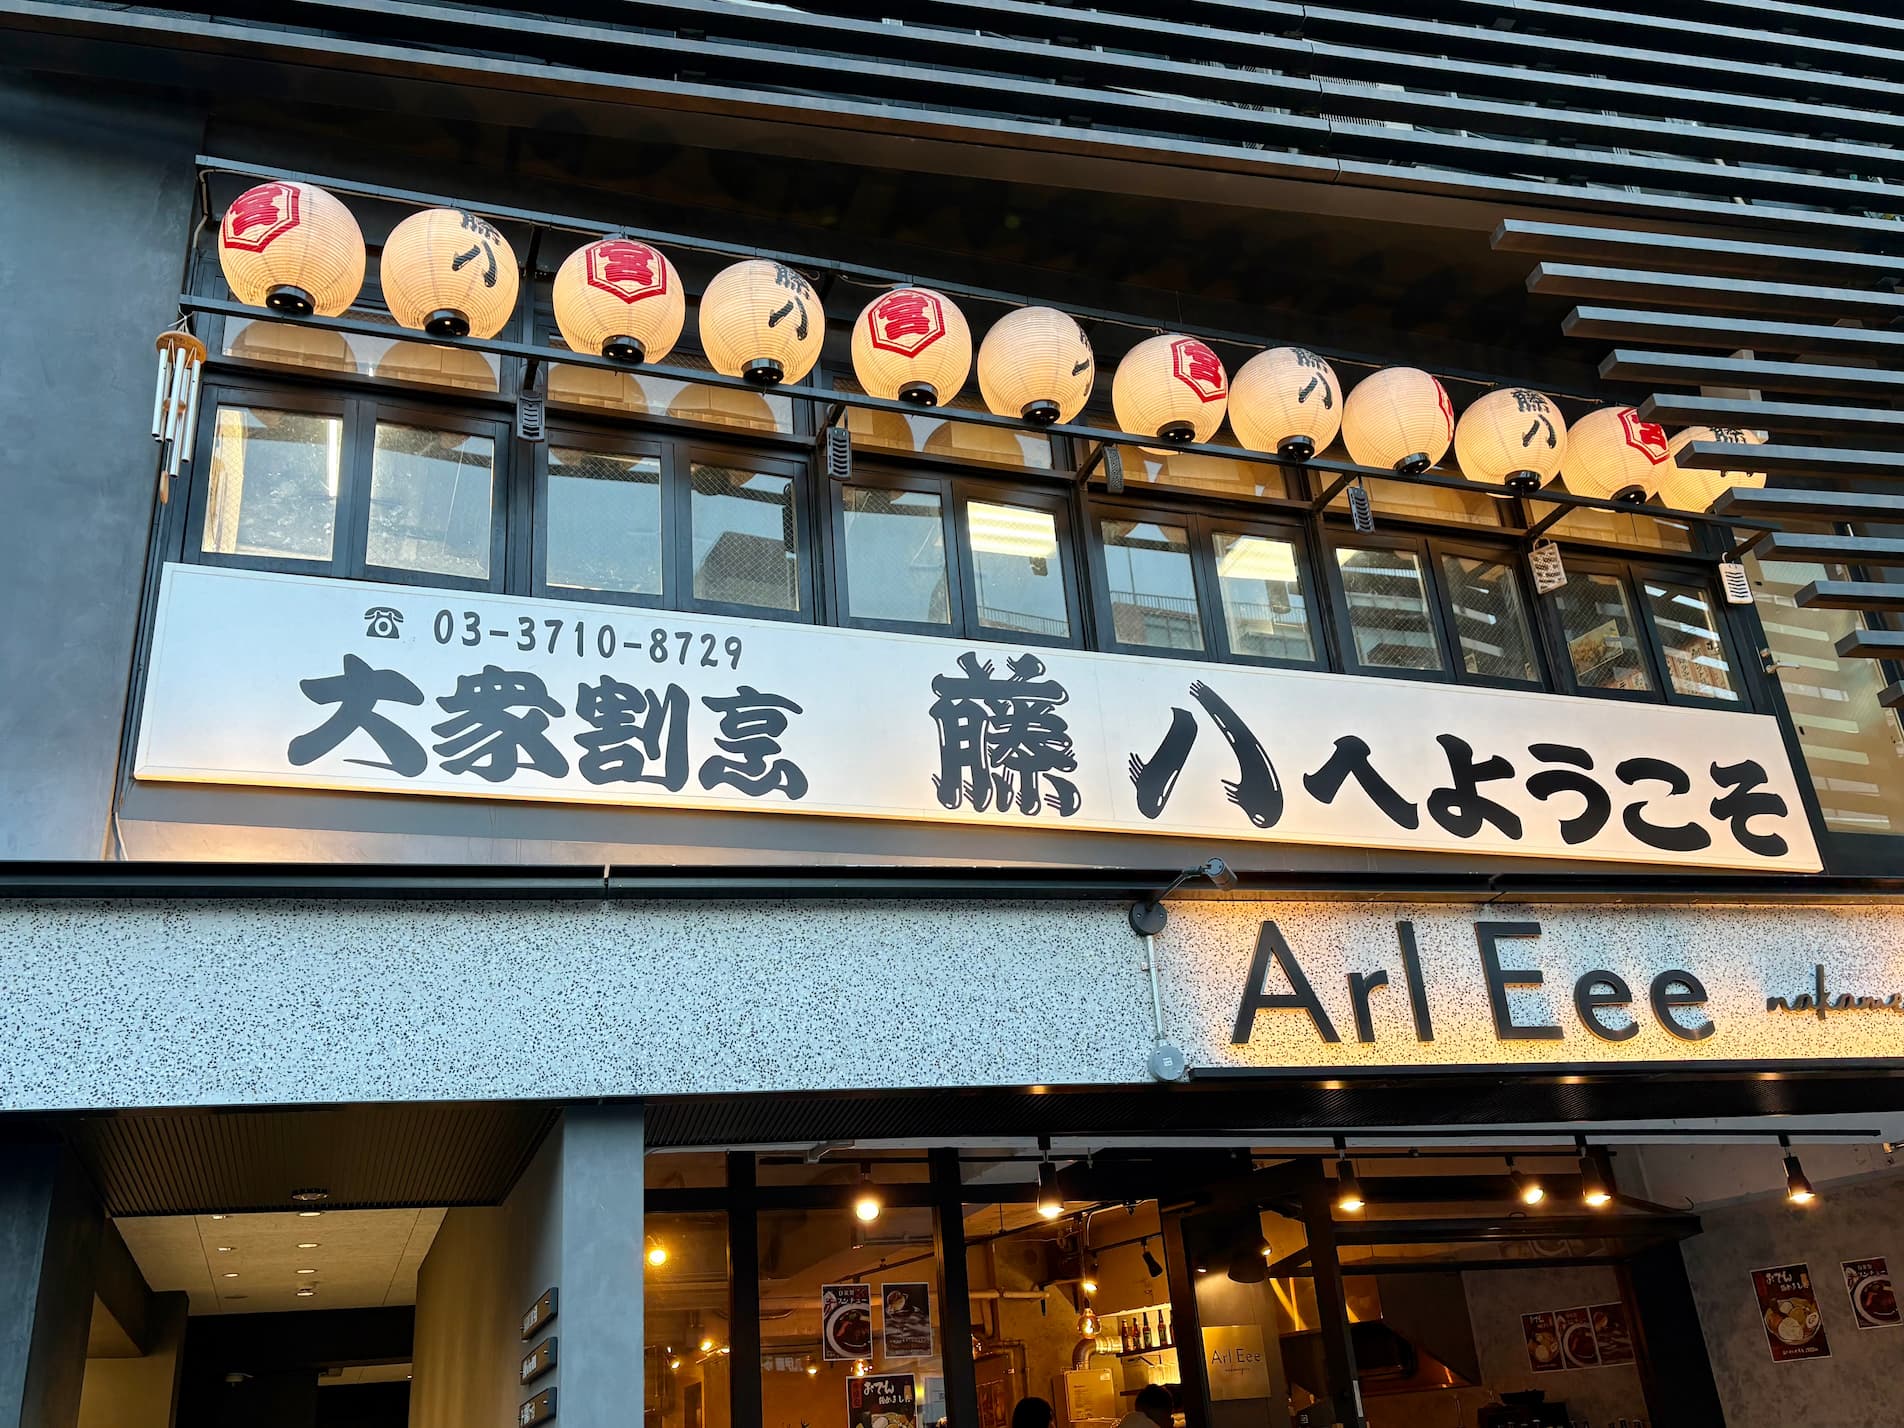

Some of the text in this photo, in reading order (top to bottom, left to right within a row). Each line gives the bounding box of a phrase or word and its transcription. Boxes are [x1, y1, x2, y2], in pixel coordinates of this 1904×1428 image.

[434, 609, 742, 670] 03-3710-8729
[287, 653, 808, 800] 大衆割烹
[1230, 921, 1904, 1044] Arl Eee nakame
[1236, 1348, 1261, 1363] Eee
